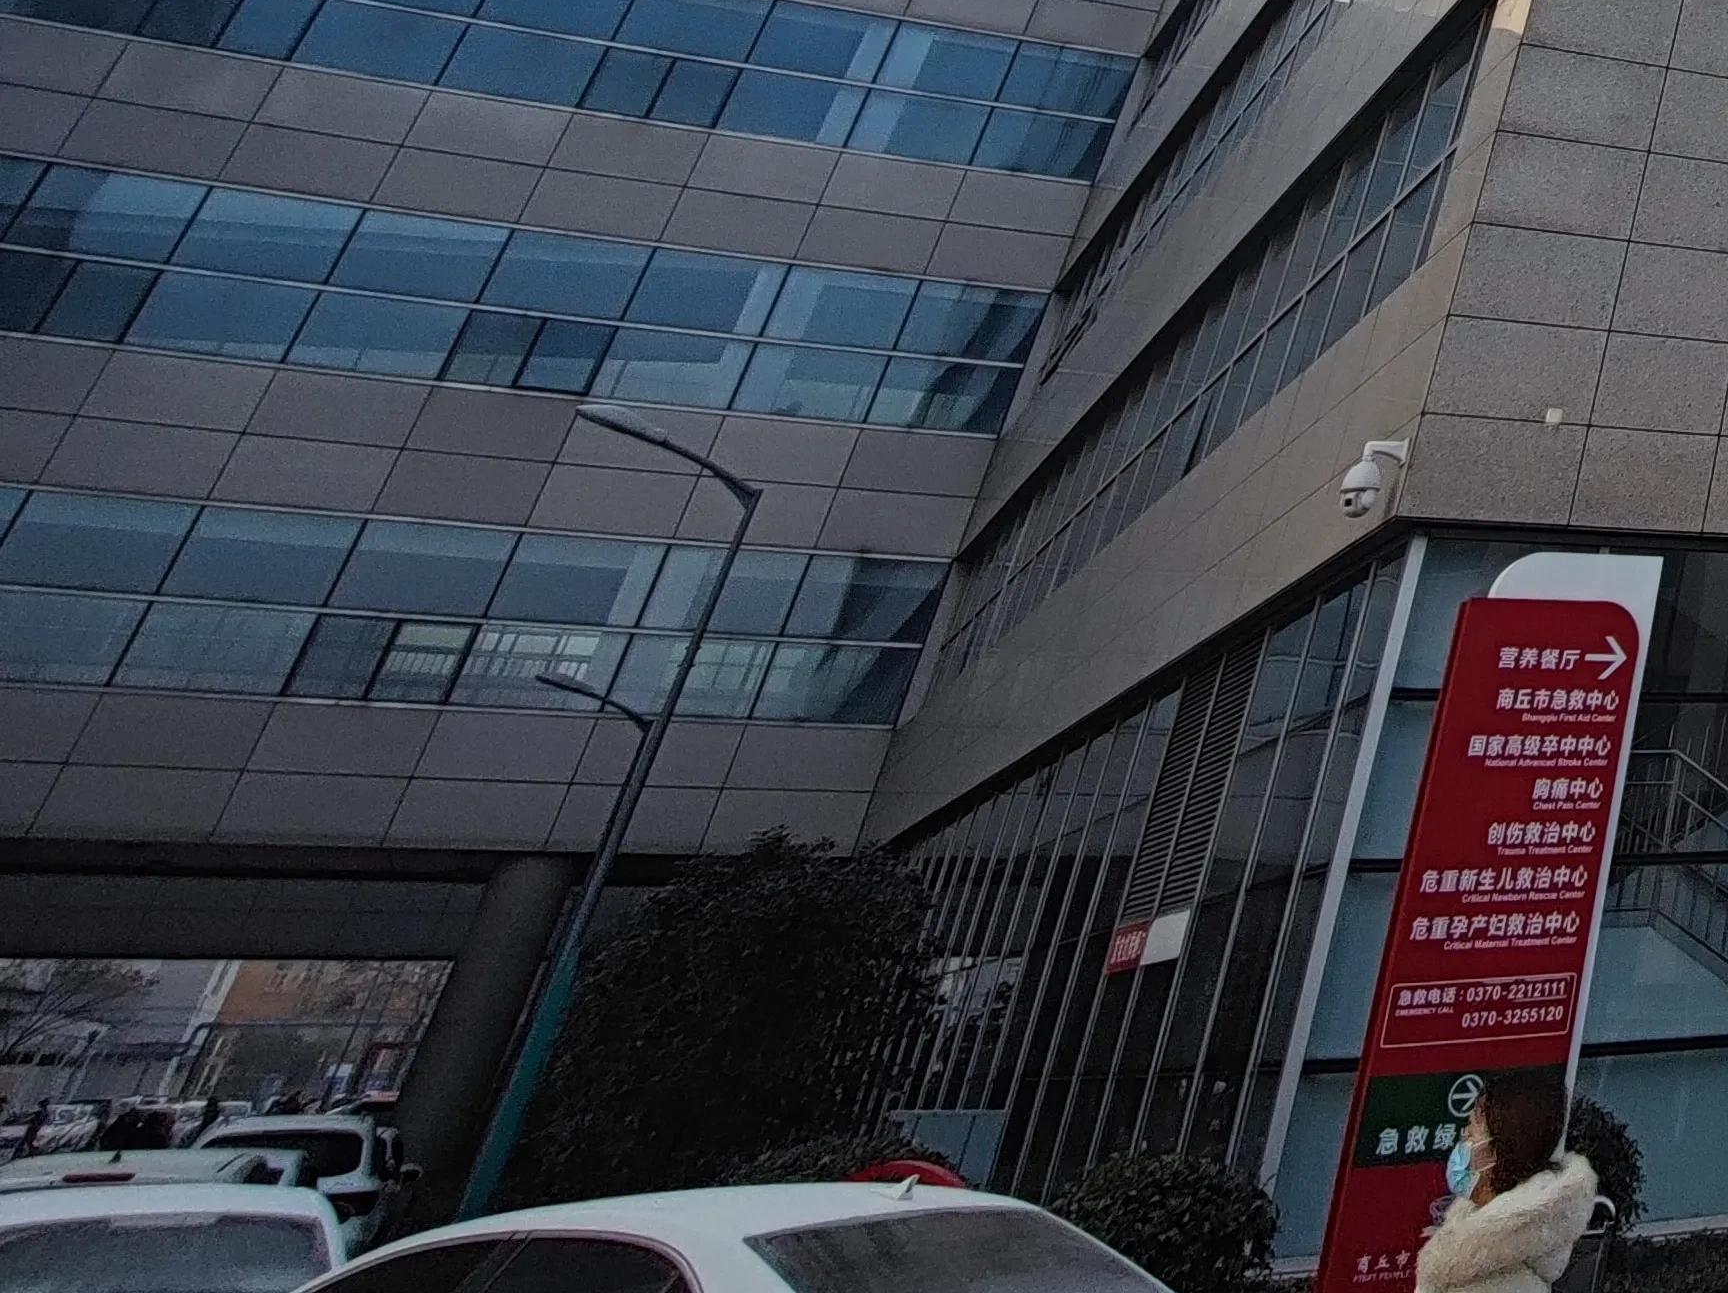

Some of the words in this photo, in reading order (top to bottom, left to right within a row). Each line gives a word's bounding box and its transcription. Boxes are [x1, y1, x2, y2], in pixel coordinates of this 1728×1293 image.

[1498, 646, 1581, 670] 营养餐厅
[1496, 688, 1620, 710] 商丘市急救中心
[1467, 734, 1611, 757] 国家高级卒中中心
[1532, 776, 1603, 800] 胸痛中心
[1487, 820, 1596, 845] 创伤救治中心
[1420, 864, 1588, 893] 危重新生儿救治中心
[1410, 910, 1580, 941] 危重孕产妇救治中心
[1461, 1006, 1564, 1029] 0370-3255120
[1376, 1123, 1468, 1155] 急救绿
[1357, 1249, 1413, 1273] 商丘市
